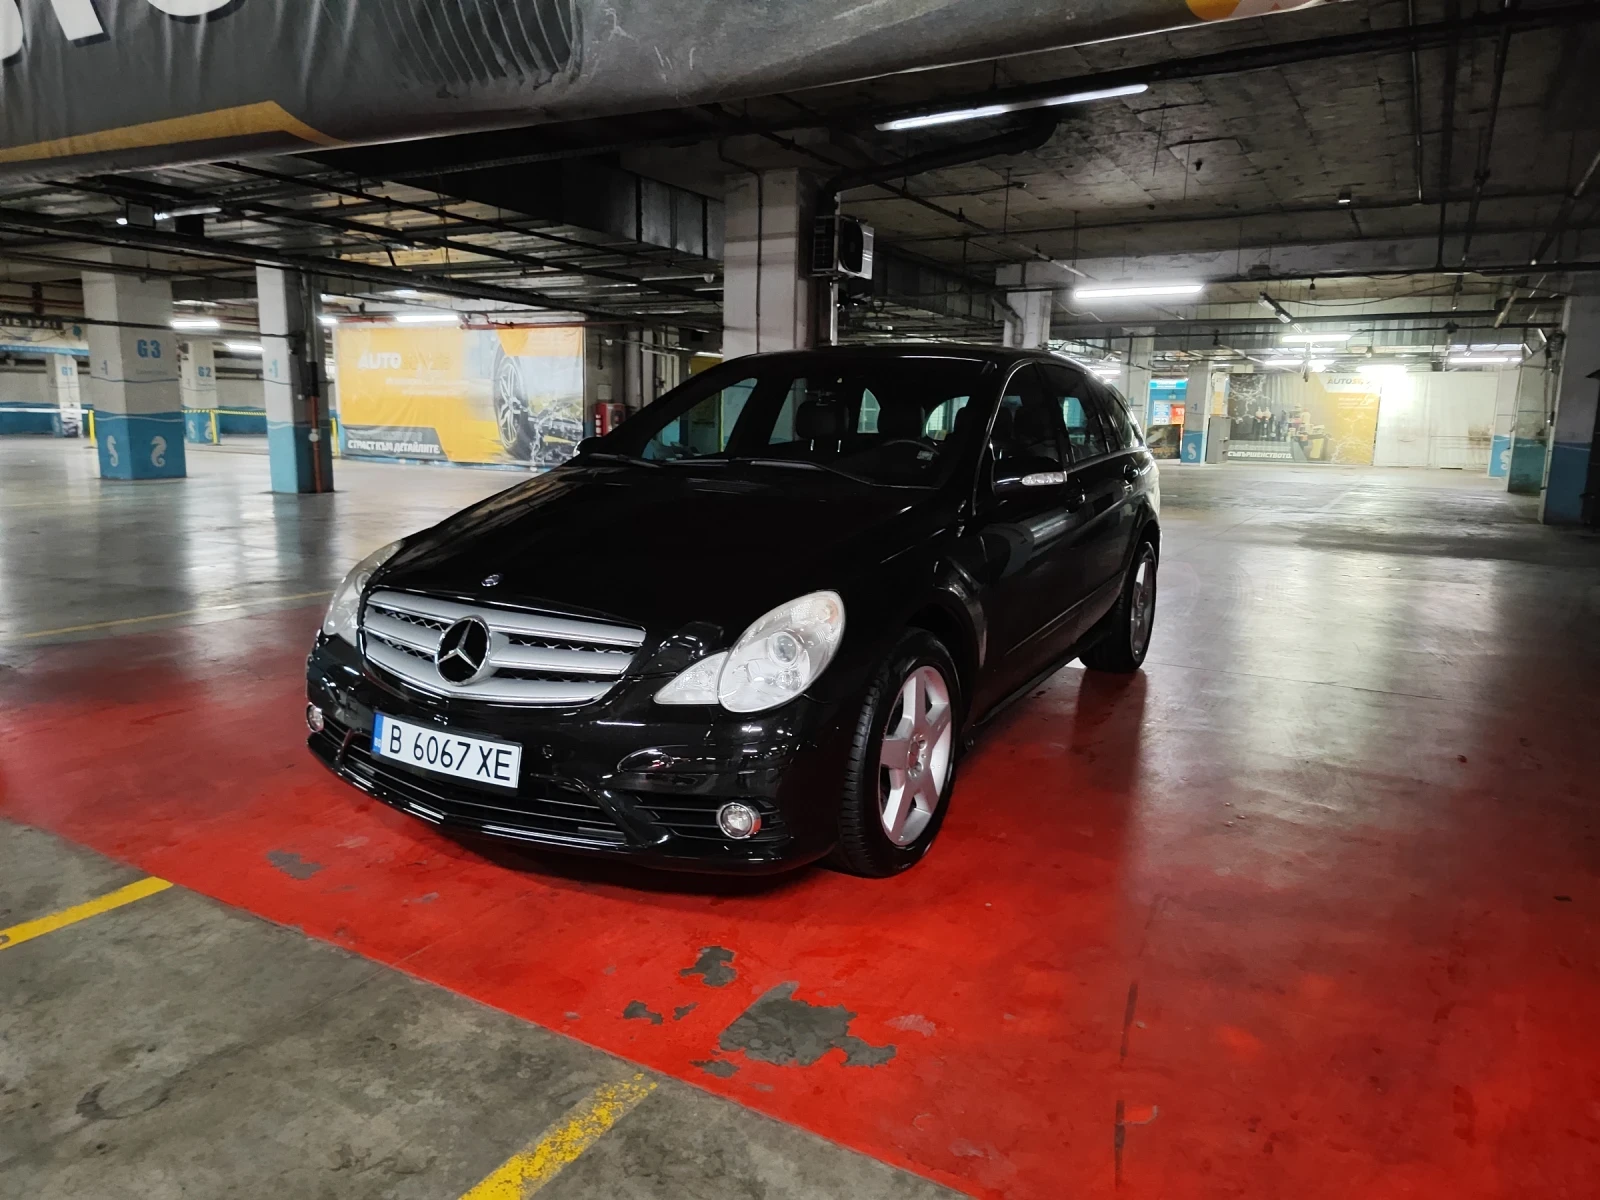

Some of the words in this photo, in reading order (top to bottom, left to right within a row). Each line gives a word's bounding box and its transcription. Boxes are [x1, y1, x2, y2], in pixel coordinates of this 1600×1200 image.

[137, 339, 161, 359] G3
[197, 365, 212, 378] G2
[347, 439, 376, 451] СТРАСТ
[375, 441, 393, 452] КЪМ
[389, 724, 402, 754] B
[412, 732, 471, 771] 6067
[476, 745, 513, 781] XE
